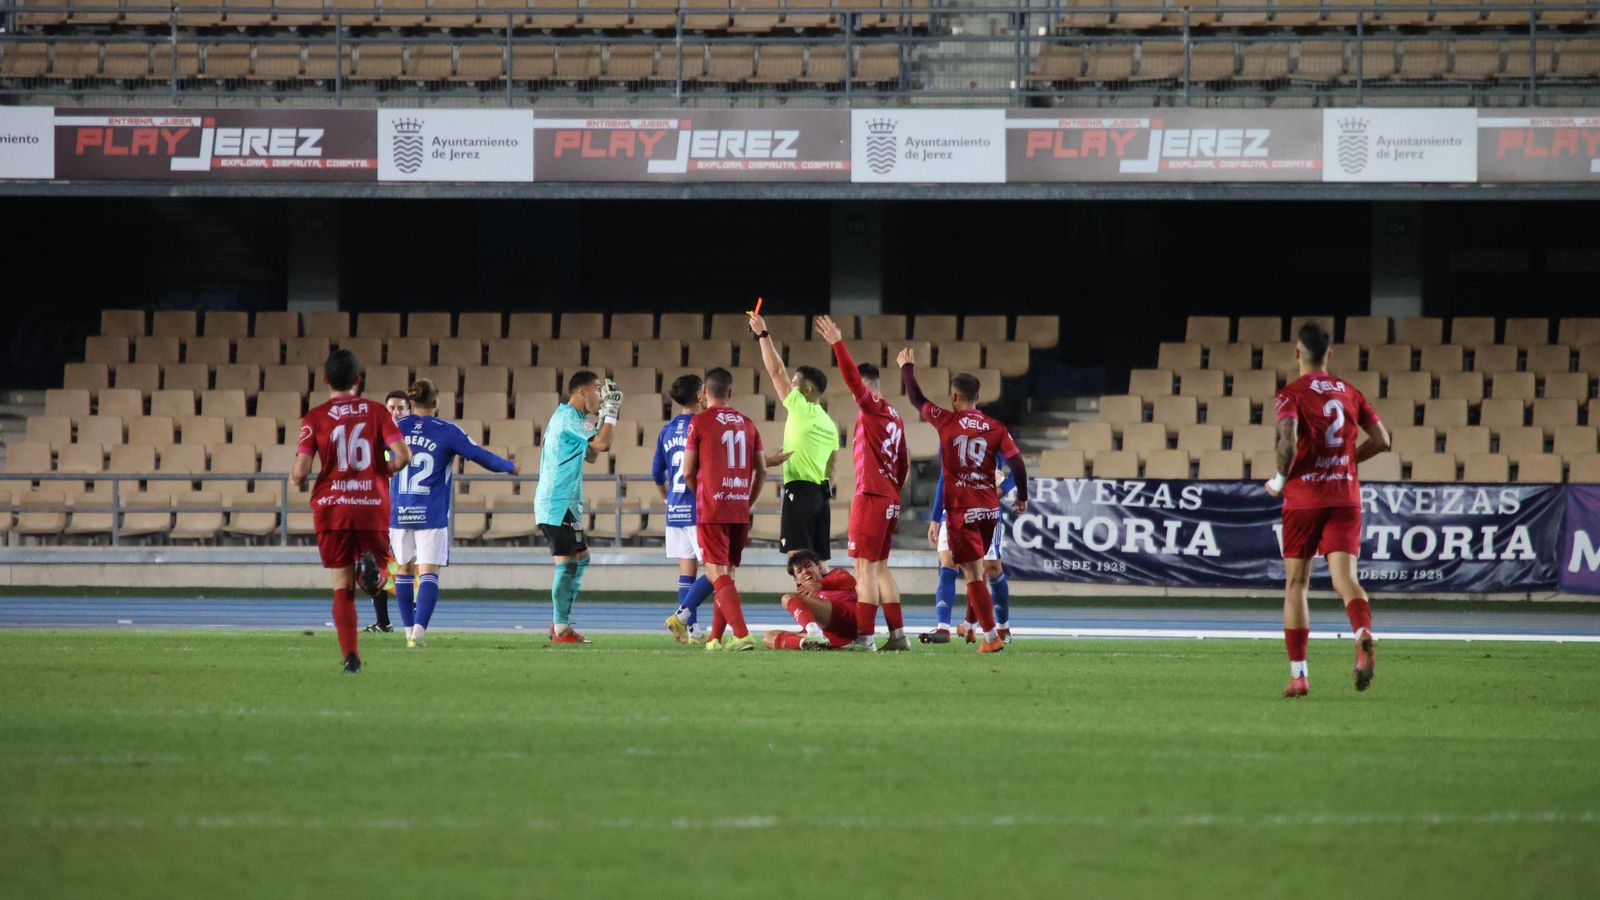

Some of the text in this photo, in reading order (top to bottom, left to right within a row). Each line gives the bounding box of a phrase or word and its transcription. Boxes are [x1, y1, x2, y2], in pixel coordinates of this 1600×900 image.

[75, 117, 324, 171] PLAY JEREZ
[431, 136, 519, 149] Ayuntamiento
[431, 149, 481, 161] de Jerez
[554, 119, 799, 173] PLAY JEREZ
[904, 136, 991, 149] Ayuntamiento
[904, 149, 953, 161] de Jerez
[1026, 118, 1272, 173] PLAY JEREZ
[1376, 136, 1463, 149] Ayuntamiento
[1376, 150, 1425, 161] de Jerez
[1498, 129, 1600, 157] PLAY
[327, 403, 368, 420] VELA
[959, 416, 990, 430] VELA
[1323, 399, 1345, 447] 2
[330, 422, 371, 472] 16
[405, 435, 437, 452] BERTO
[721, 429, 747, 469] 11
[952, 434, 988, 468] 19
[398, 452, 435, 496] 12
[1033, 477, 1203, 511] RVEZAS
[1360, 487, 1522, 515] RVEZAS
[1003, 514, 1222, 558] CTORIA
[1043, 559, 1127, 572] DESDE 1928
[1359, 569, 1444, 580] DESDE 1928
